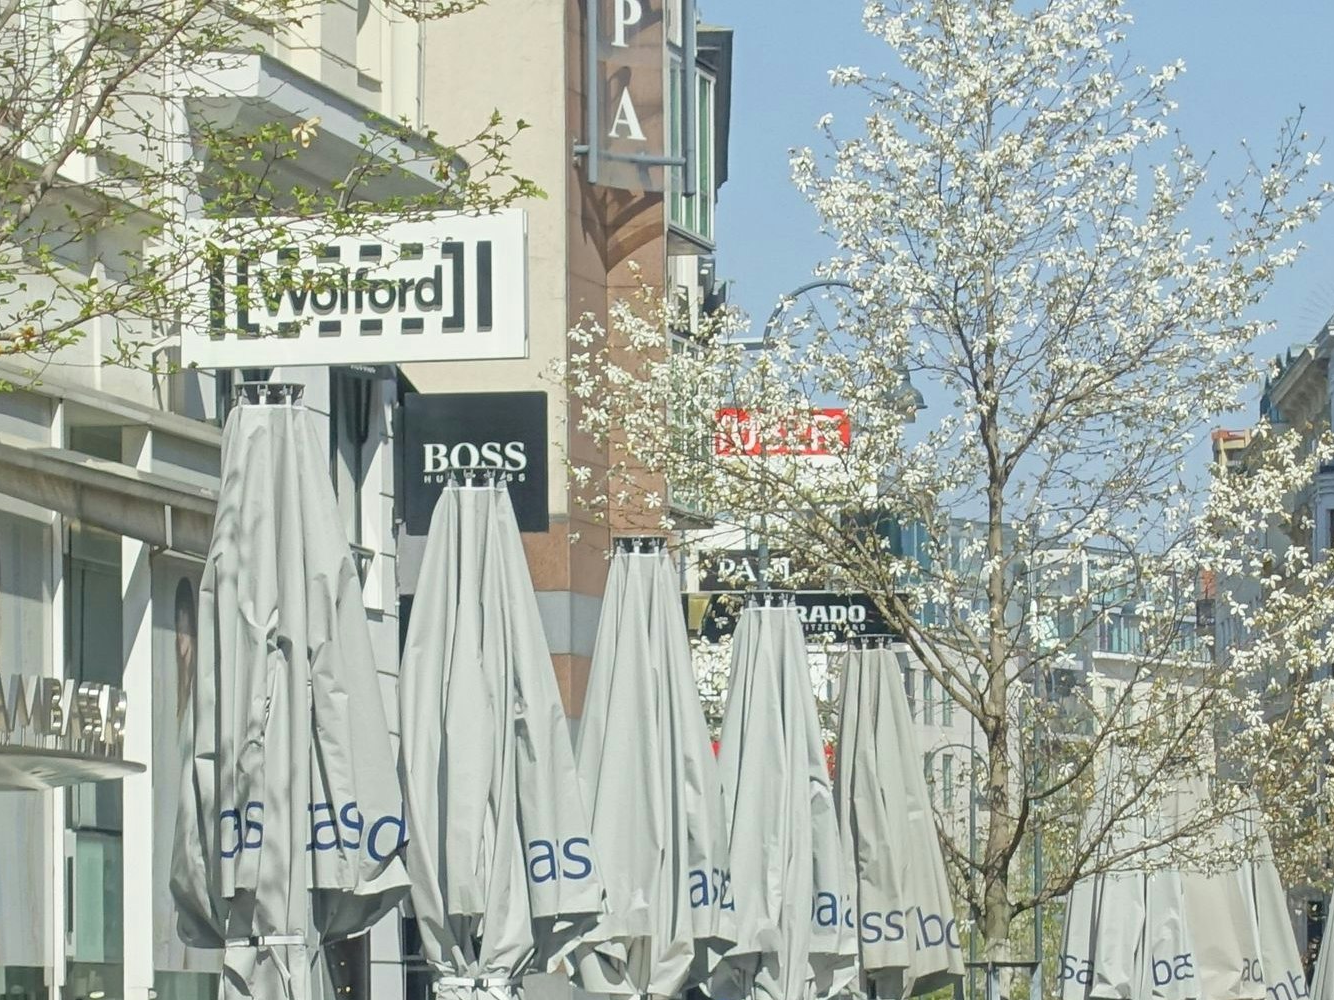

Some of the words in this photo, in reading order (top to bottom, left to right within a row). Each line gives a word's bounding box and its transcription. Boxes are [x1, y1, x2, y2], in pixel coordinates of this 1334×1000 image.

[258, 265, 443, 315] Wolford
[423, 441, 527, 472] BOSS
[797, 605, 865, 623] RADO
[529, 837, 592, 883] as
